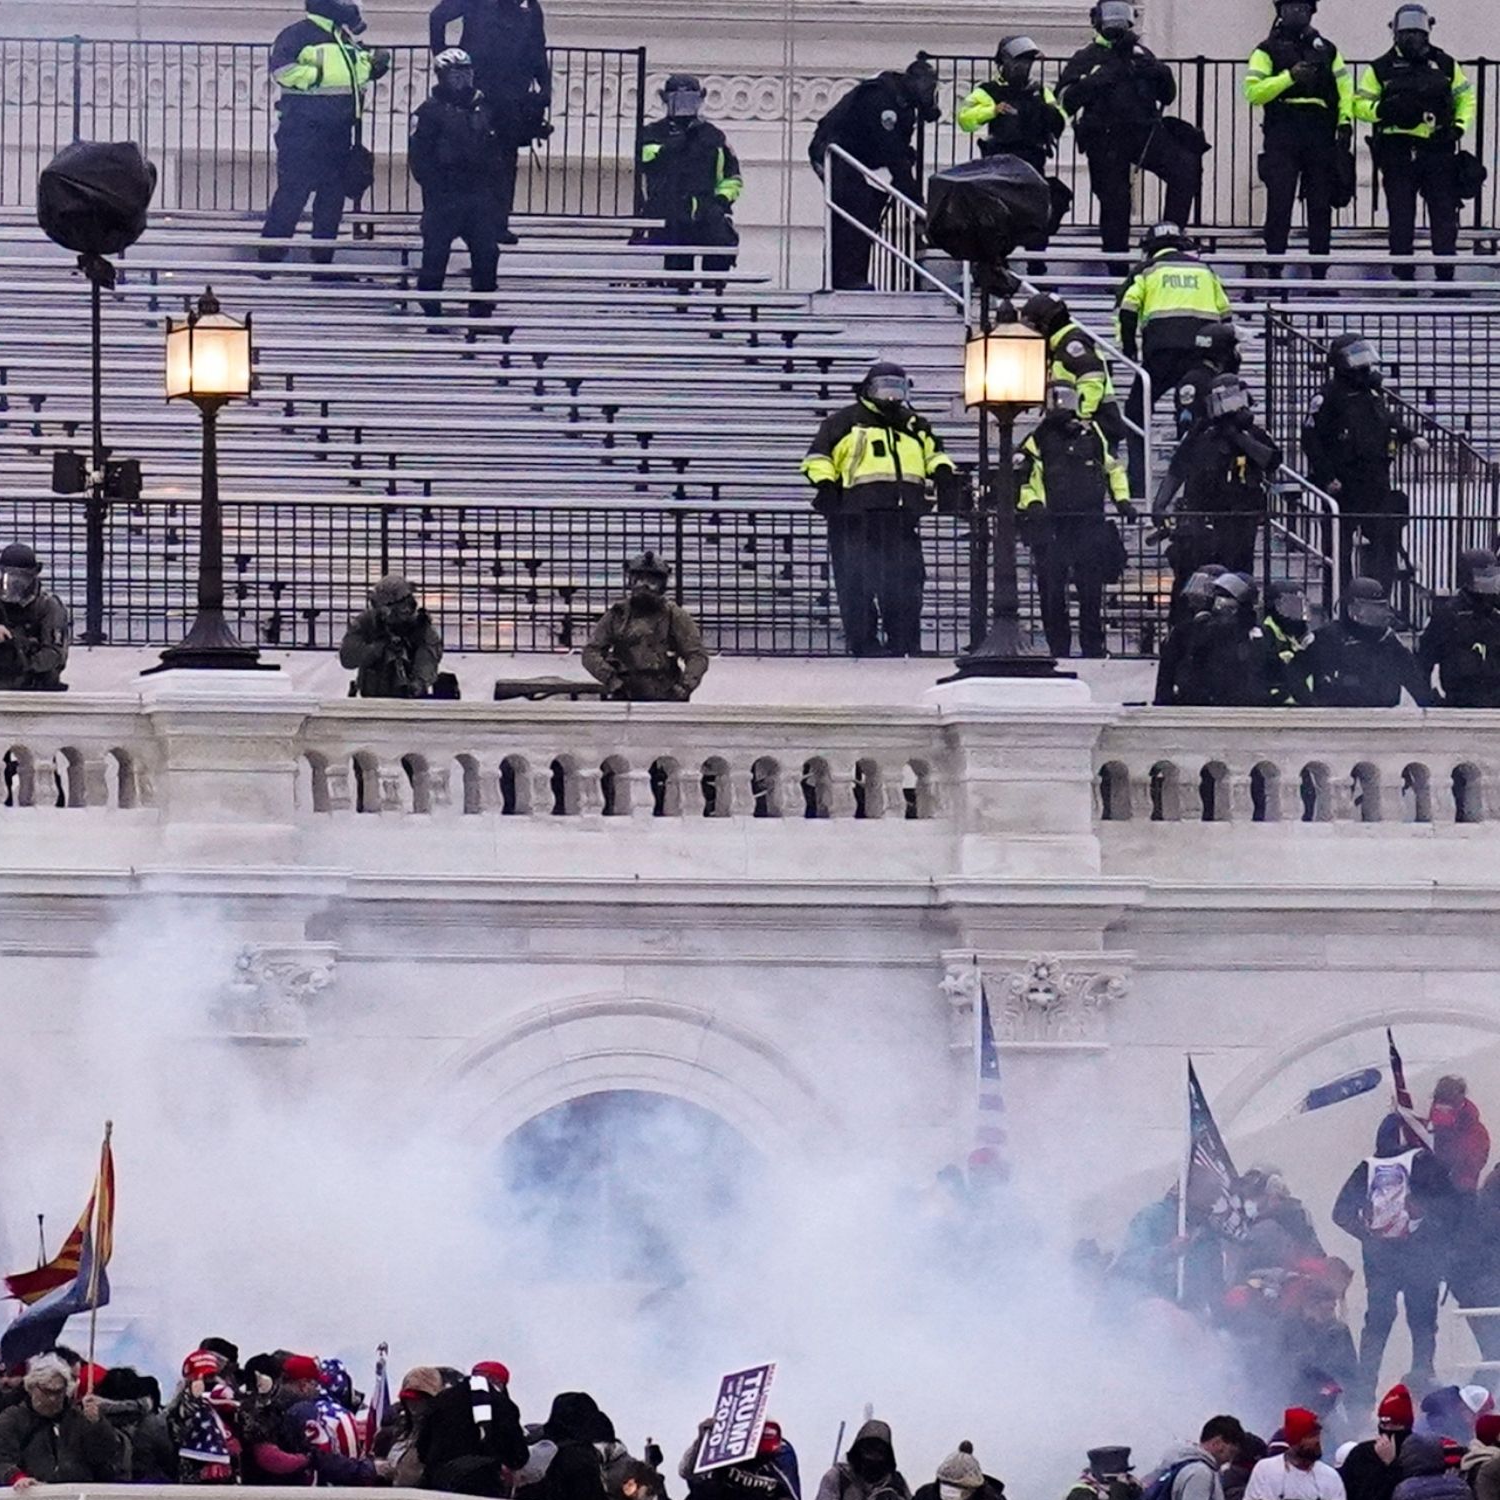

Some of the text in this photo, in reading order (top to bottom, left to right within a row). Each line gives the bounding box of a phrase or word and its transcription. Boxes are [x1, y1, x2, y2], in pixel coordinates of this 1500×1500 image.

[1161, 273, 1200, 290] POLICE
[709, 1394, 735, 1448] 2020
[726, 1370, 765, 1456] TRUMP
